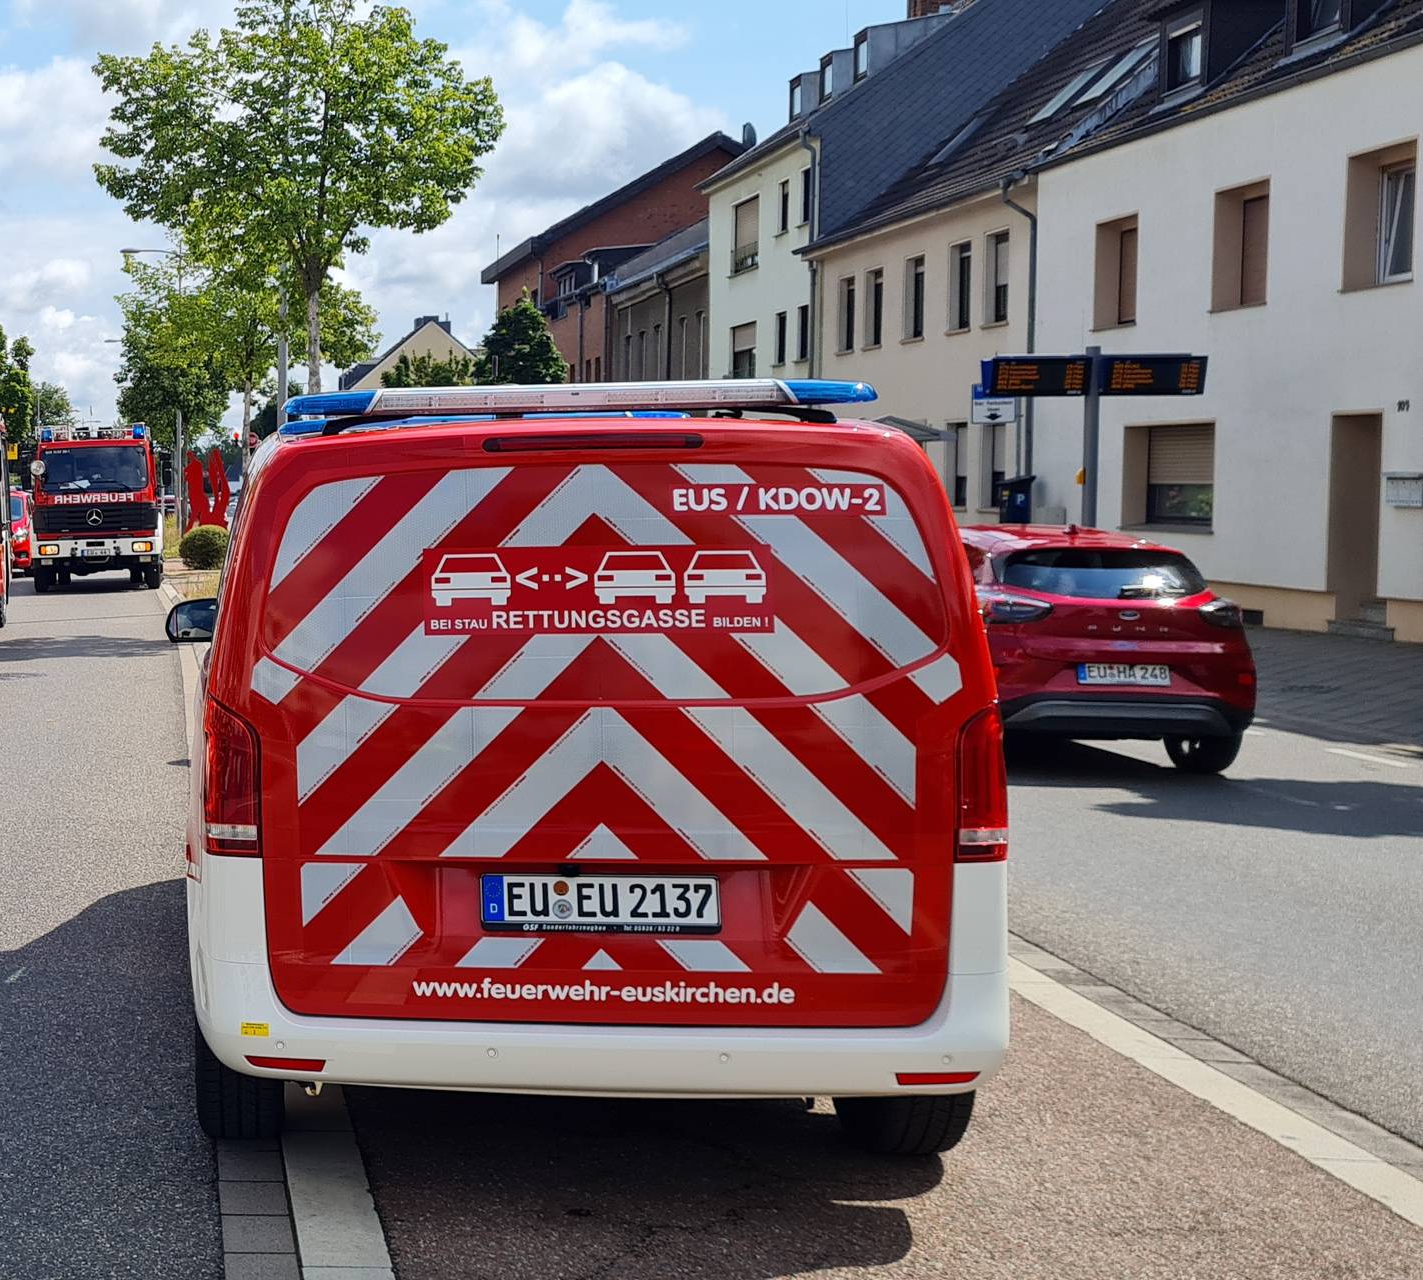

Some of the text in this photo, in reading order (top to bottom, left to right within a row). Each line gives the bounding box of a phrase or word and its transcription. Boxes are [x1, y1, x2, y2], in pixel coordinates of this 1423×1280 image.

[672, 487, 728, 511] EUS
[758, 487, 881, 511] KDOW-2
[430, 620, 452, 630] BEI
[454, 619, 488, 630] STAU
[491, 609, 706, 630] RETTUNGSGASSE
[713, 617, 761, 628] BILDEN
[1088, 665, 1107, 679] EU
[1117, 666, 1137, 679] HA
[506, 882, 713, 918] EU EU 2137
[412, 978, 795, 1004] www.feuerwehr-euskirchen.de
